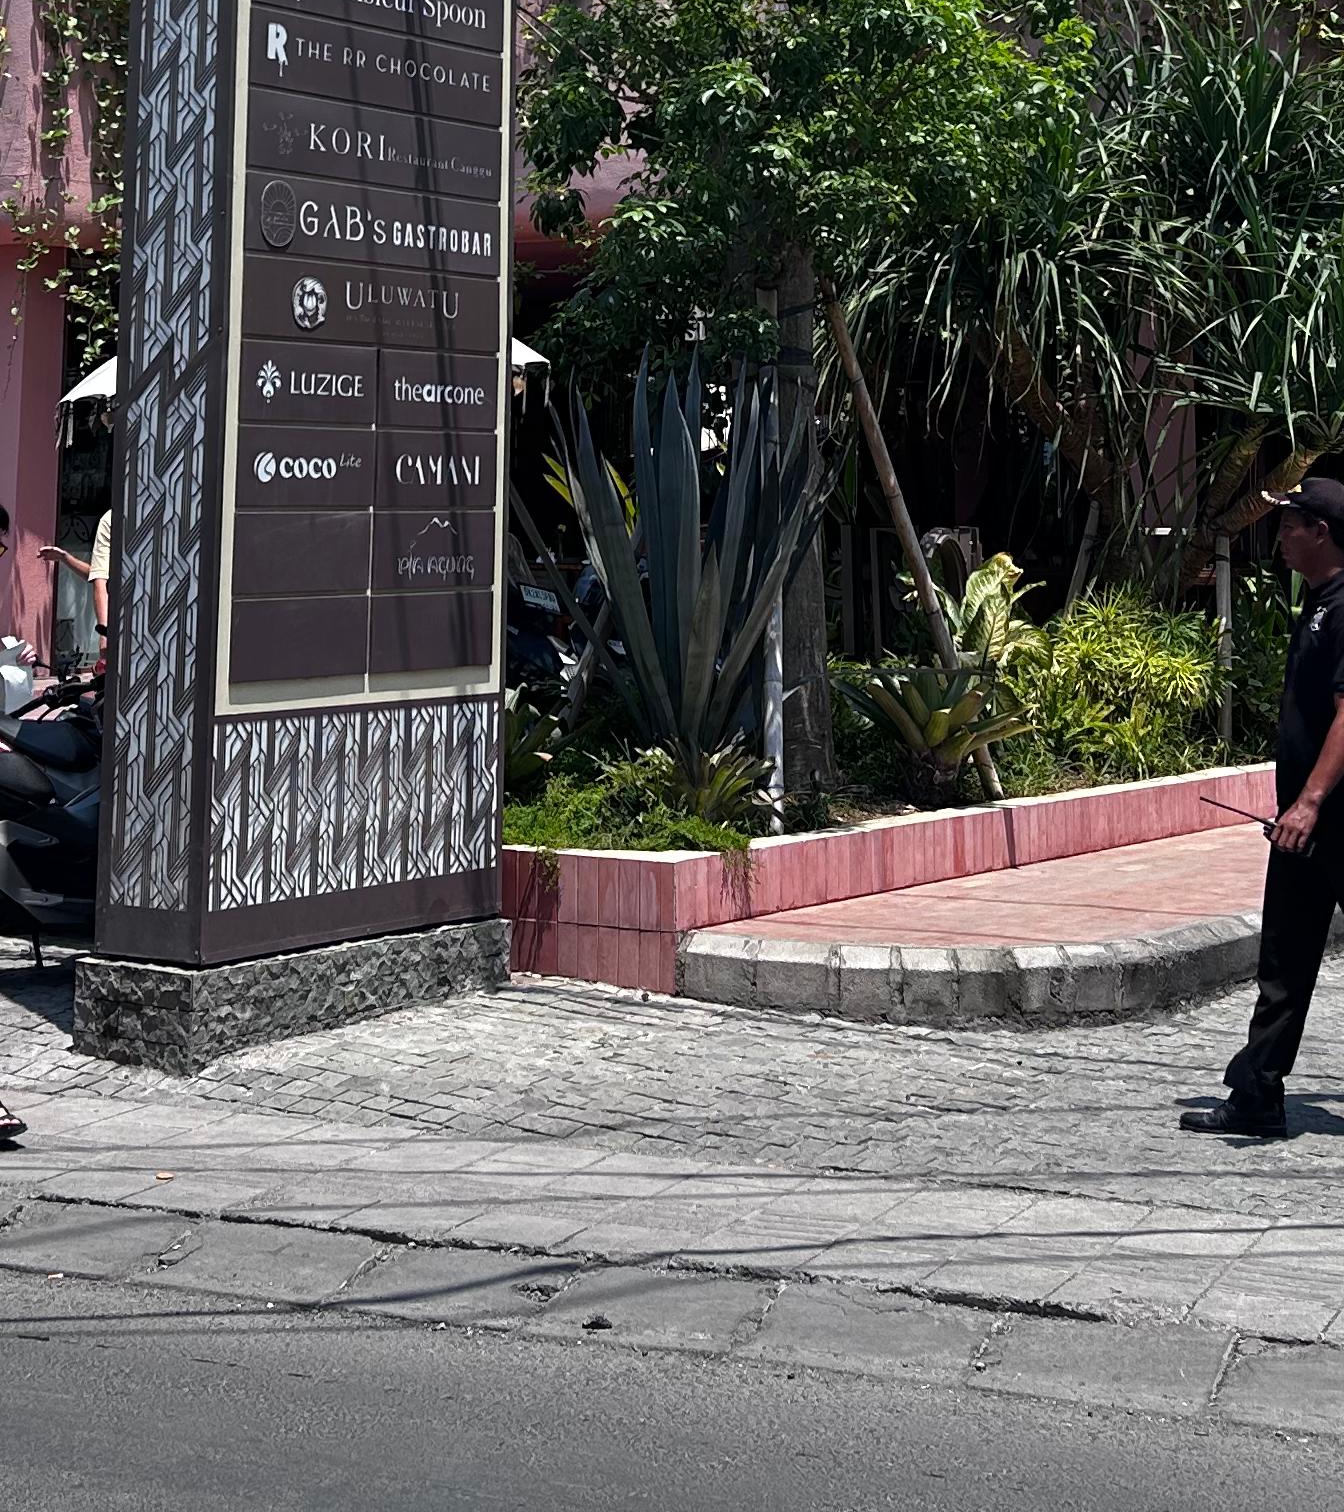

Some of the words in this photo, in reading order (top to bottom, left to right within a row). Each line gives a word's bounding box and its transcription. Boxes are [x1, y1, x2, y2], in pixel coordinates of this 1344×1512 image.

[295, 37, 333, 62] THE
[343, 46, 367, 69] RR
[375, 53, 492, 93] CHOCOLATE
[309, 122, 385, 162] KORI
[392, 220, 492, 257] GASTROBAR
[290, 370, 365, 398] LUZIGE
[394, 376, 485, 405] thearcone
[395, 454, 480, 486] CAMANI
